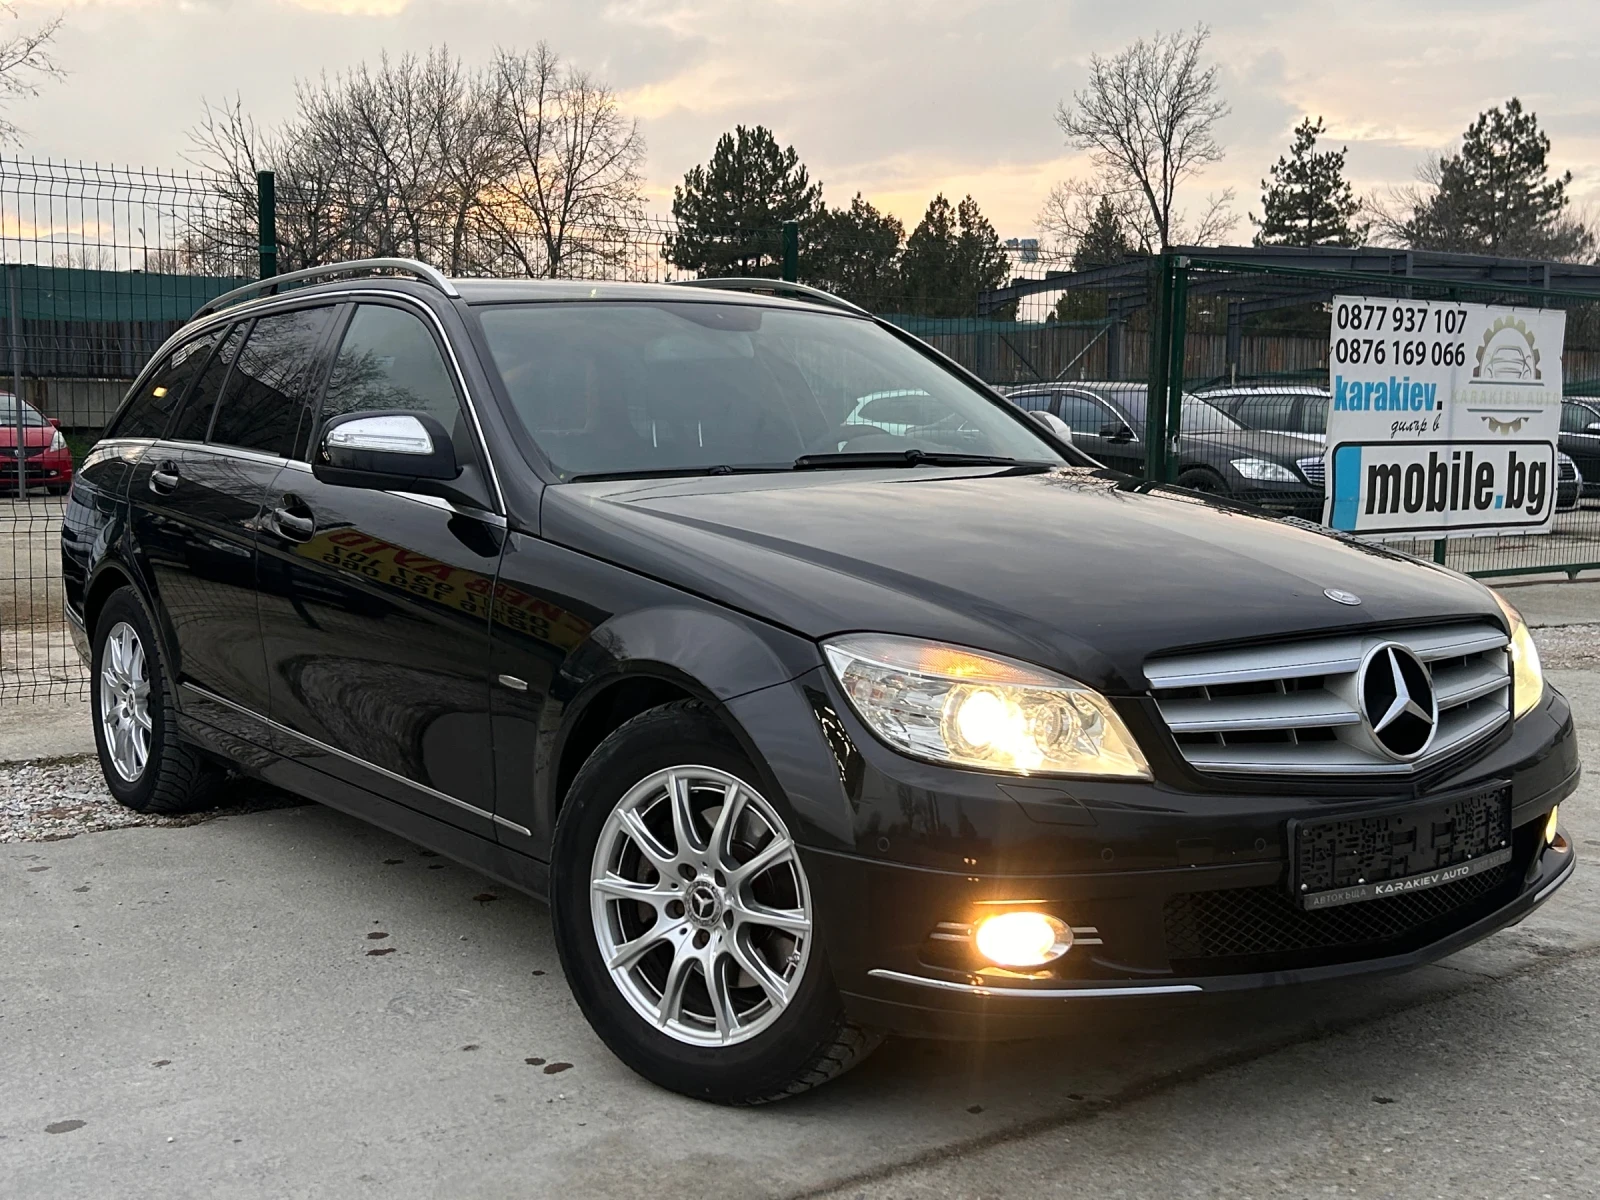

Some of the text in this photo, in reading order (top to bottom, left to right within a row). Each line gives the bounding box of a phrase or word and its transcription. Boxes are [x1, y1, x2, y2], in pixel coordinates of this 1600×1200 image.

[1336, 303, 1468, 334] 0877 937 107
[1335, 338, 1466, 367] 0876 169 066
[1451, 389, 1560, 406] KARAKIEV AUTO
[1365, 450, 1547, 515] mobile.bg
[1375, 866, 1469, 895] KARAKIEV AUTO
